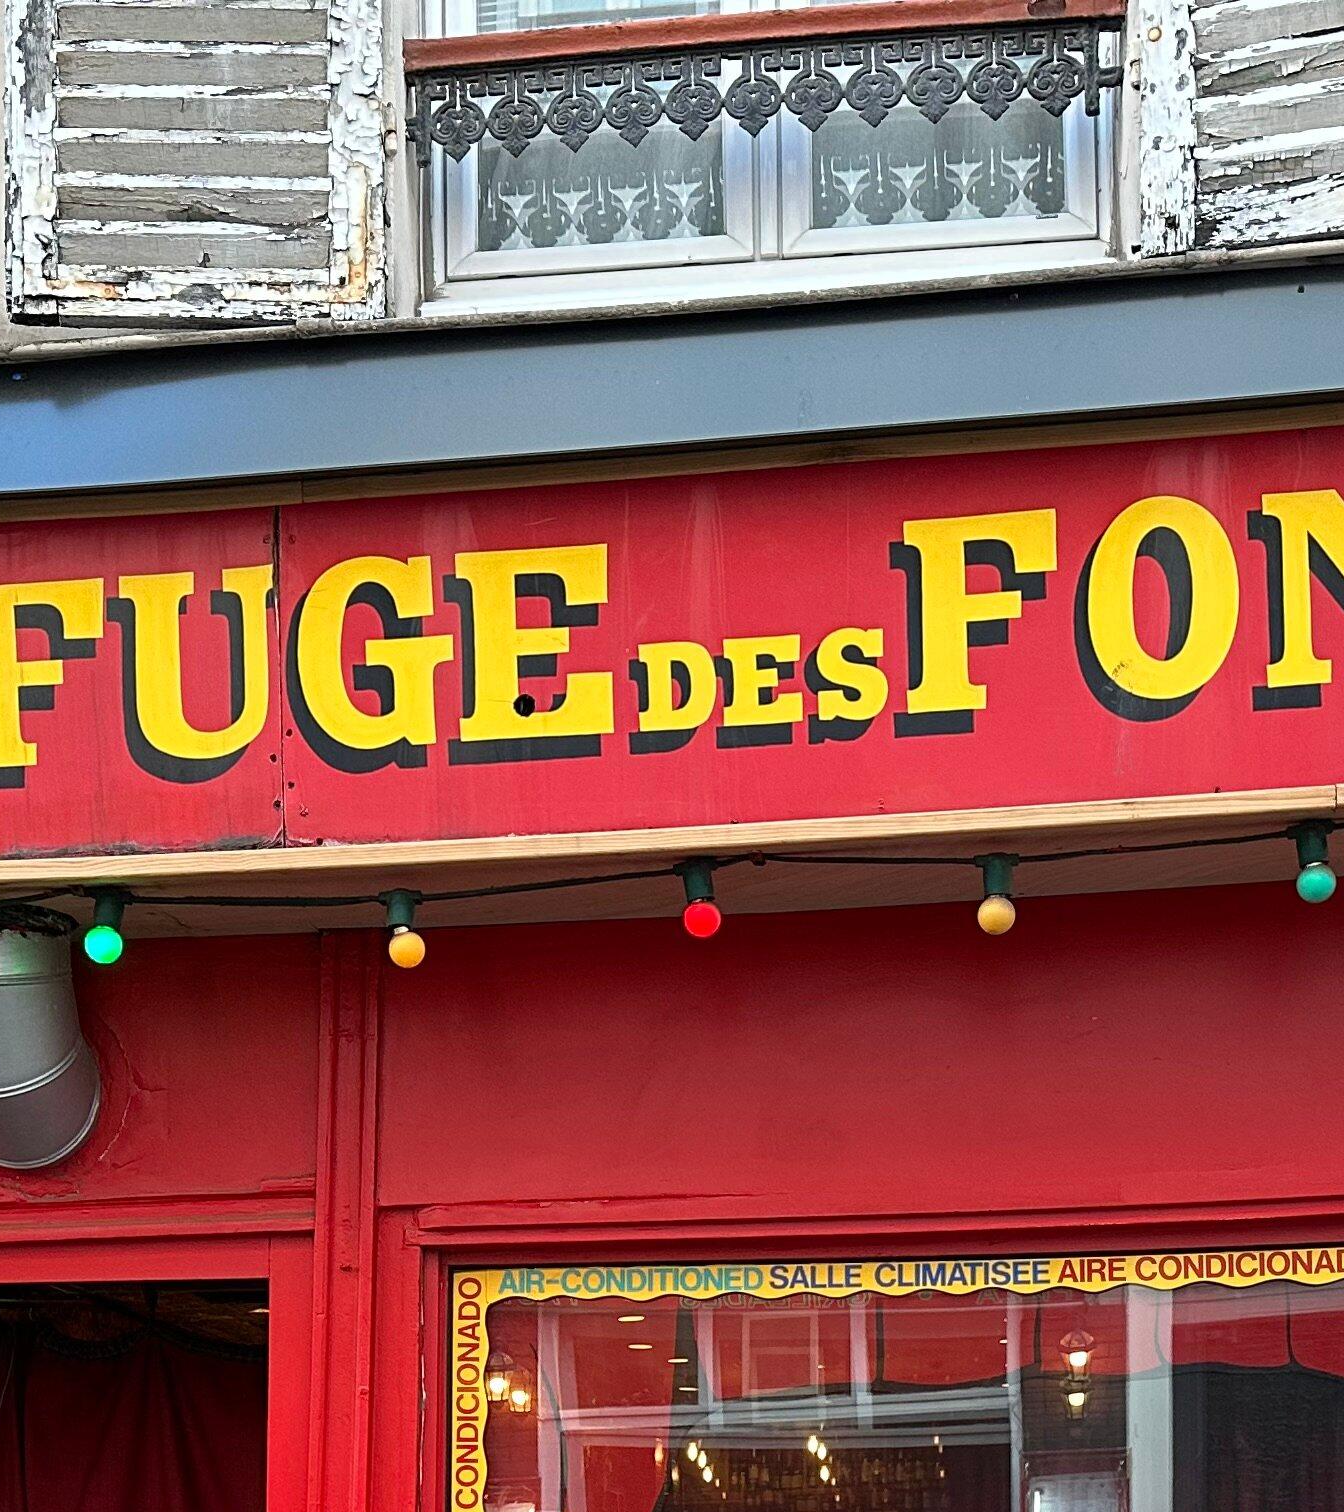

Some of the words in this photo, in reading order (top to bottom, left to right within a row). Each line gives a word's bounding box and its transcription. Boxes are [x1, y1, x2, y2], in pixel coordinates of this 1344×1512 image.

[630, 627, 887, 754] DES
[498, 1266, 764, 1293] AIR-CONDITIONED
[769, 1262, 861, 1290] SALLE
[874, 1260, 1050, 1288] CLIMATISEE
[1057, 1257, 1126, 1283] AIRE
[456, 1277, 482, 1510] CONDICIONADO
